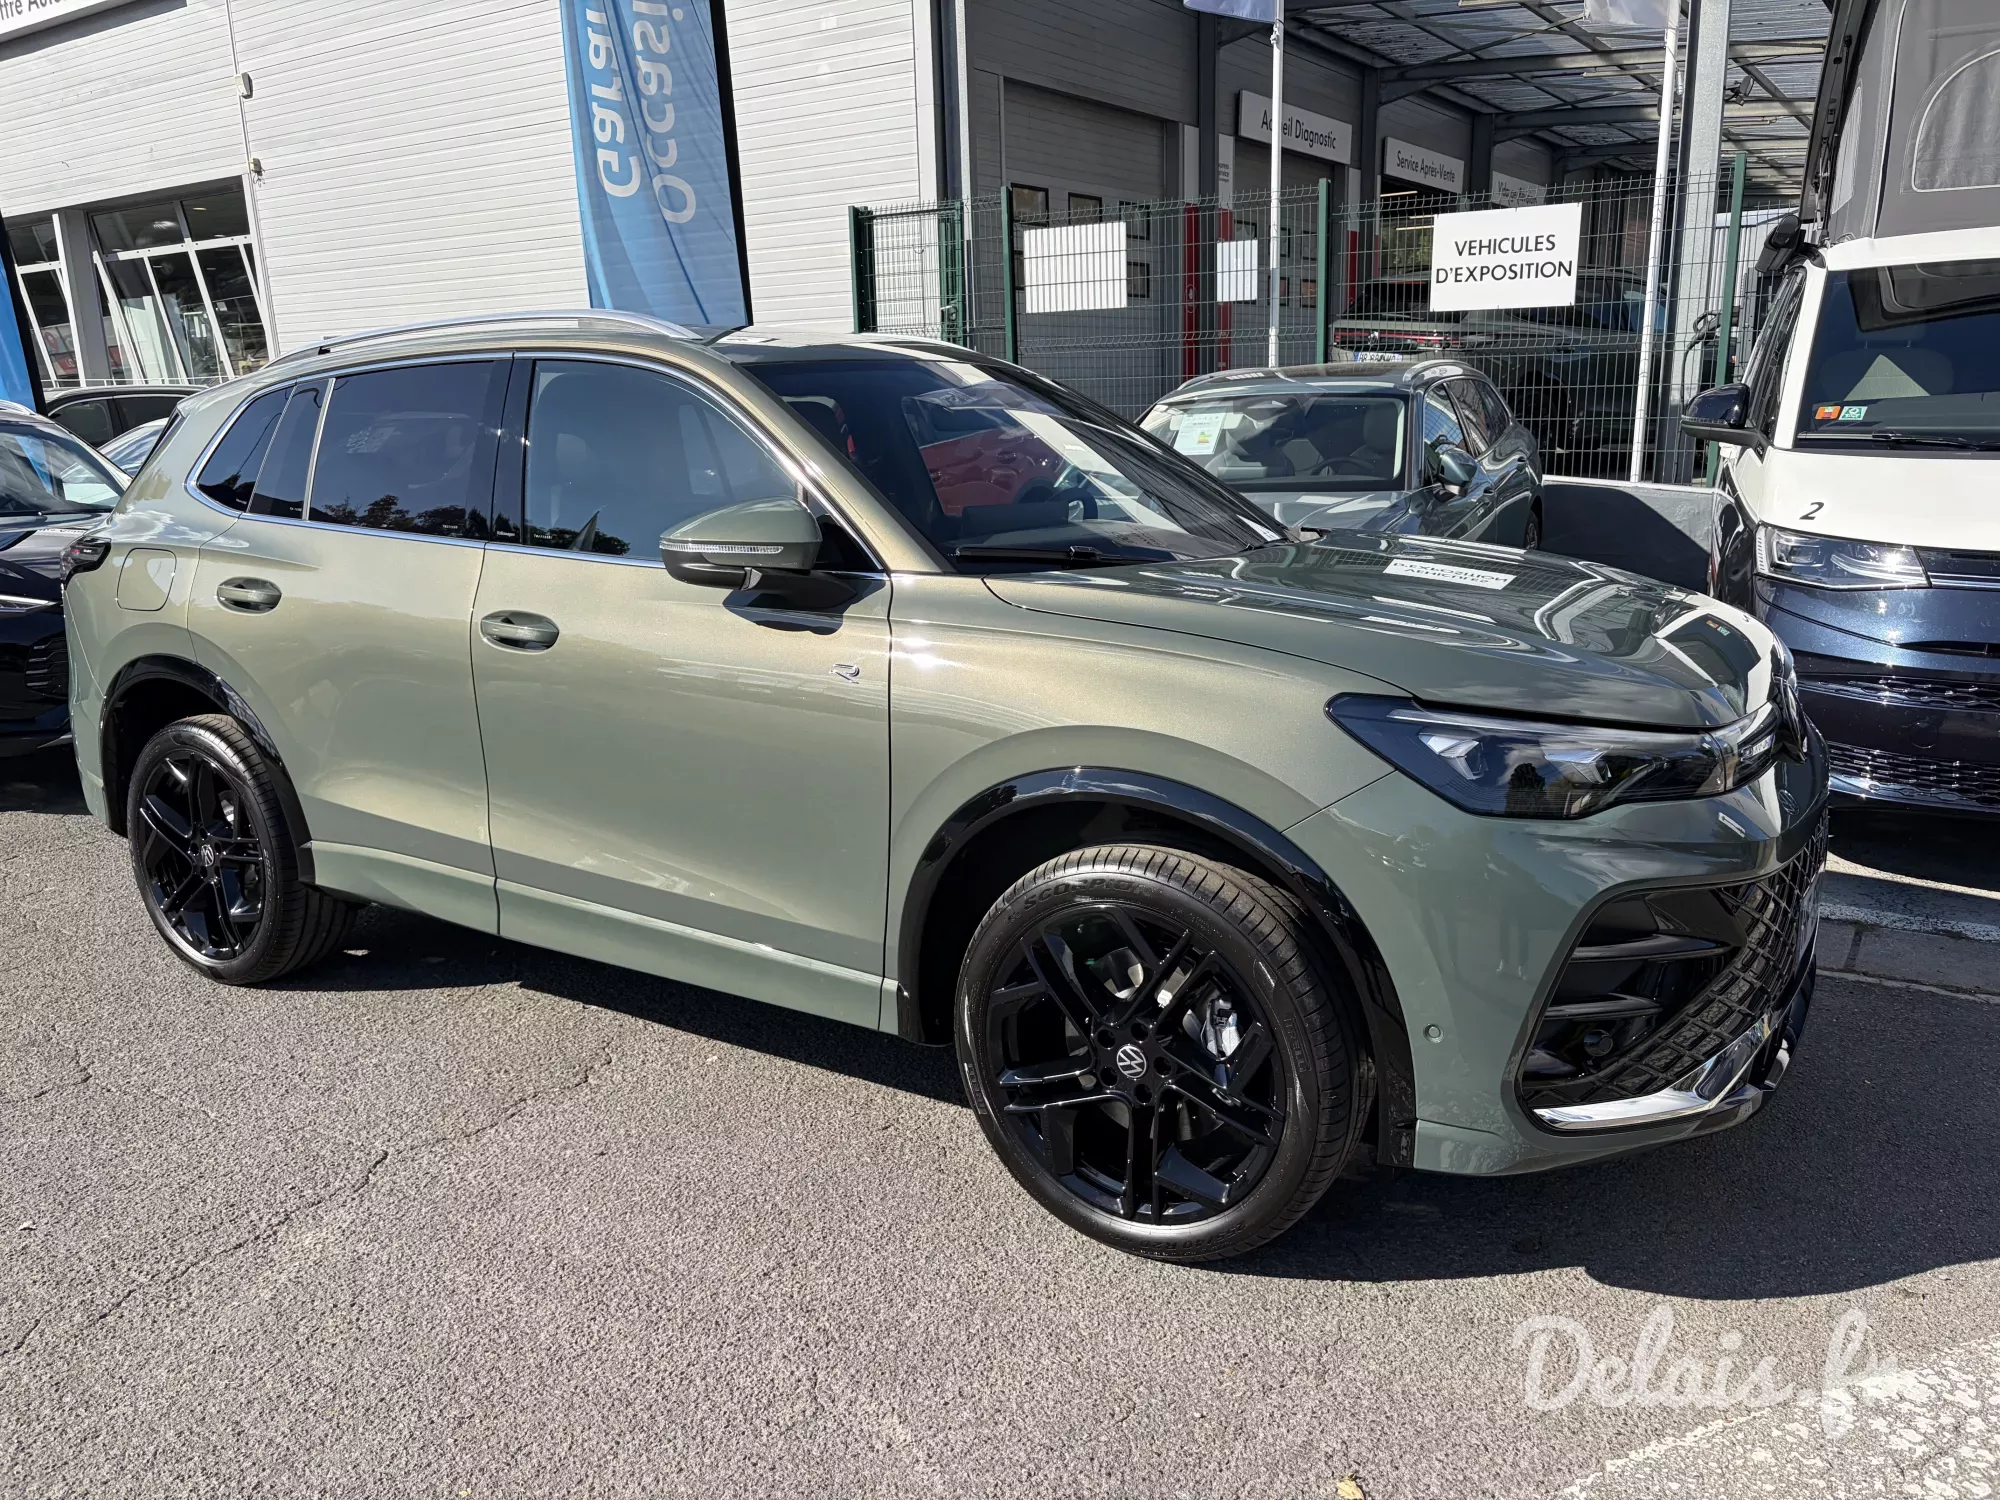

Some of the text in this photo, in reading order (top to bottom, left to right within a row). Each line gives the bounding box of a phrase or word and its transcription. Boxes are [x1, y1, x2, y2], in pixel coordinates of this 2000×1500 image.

[1260, 109, 1337, 149] Aceil Diagnostic
[1396, 149, 1419, 173] Service
[1454, 233, 1557, 257] VEHICULES
[1435, 260, 1573, 284] D'EXPOSITION
[1799, 501, 1824, 521] 2
